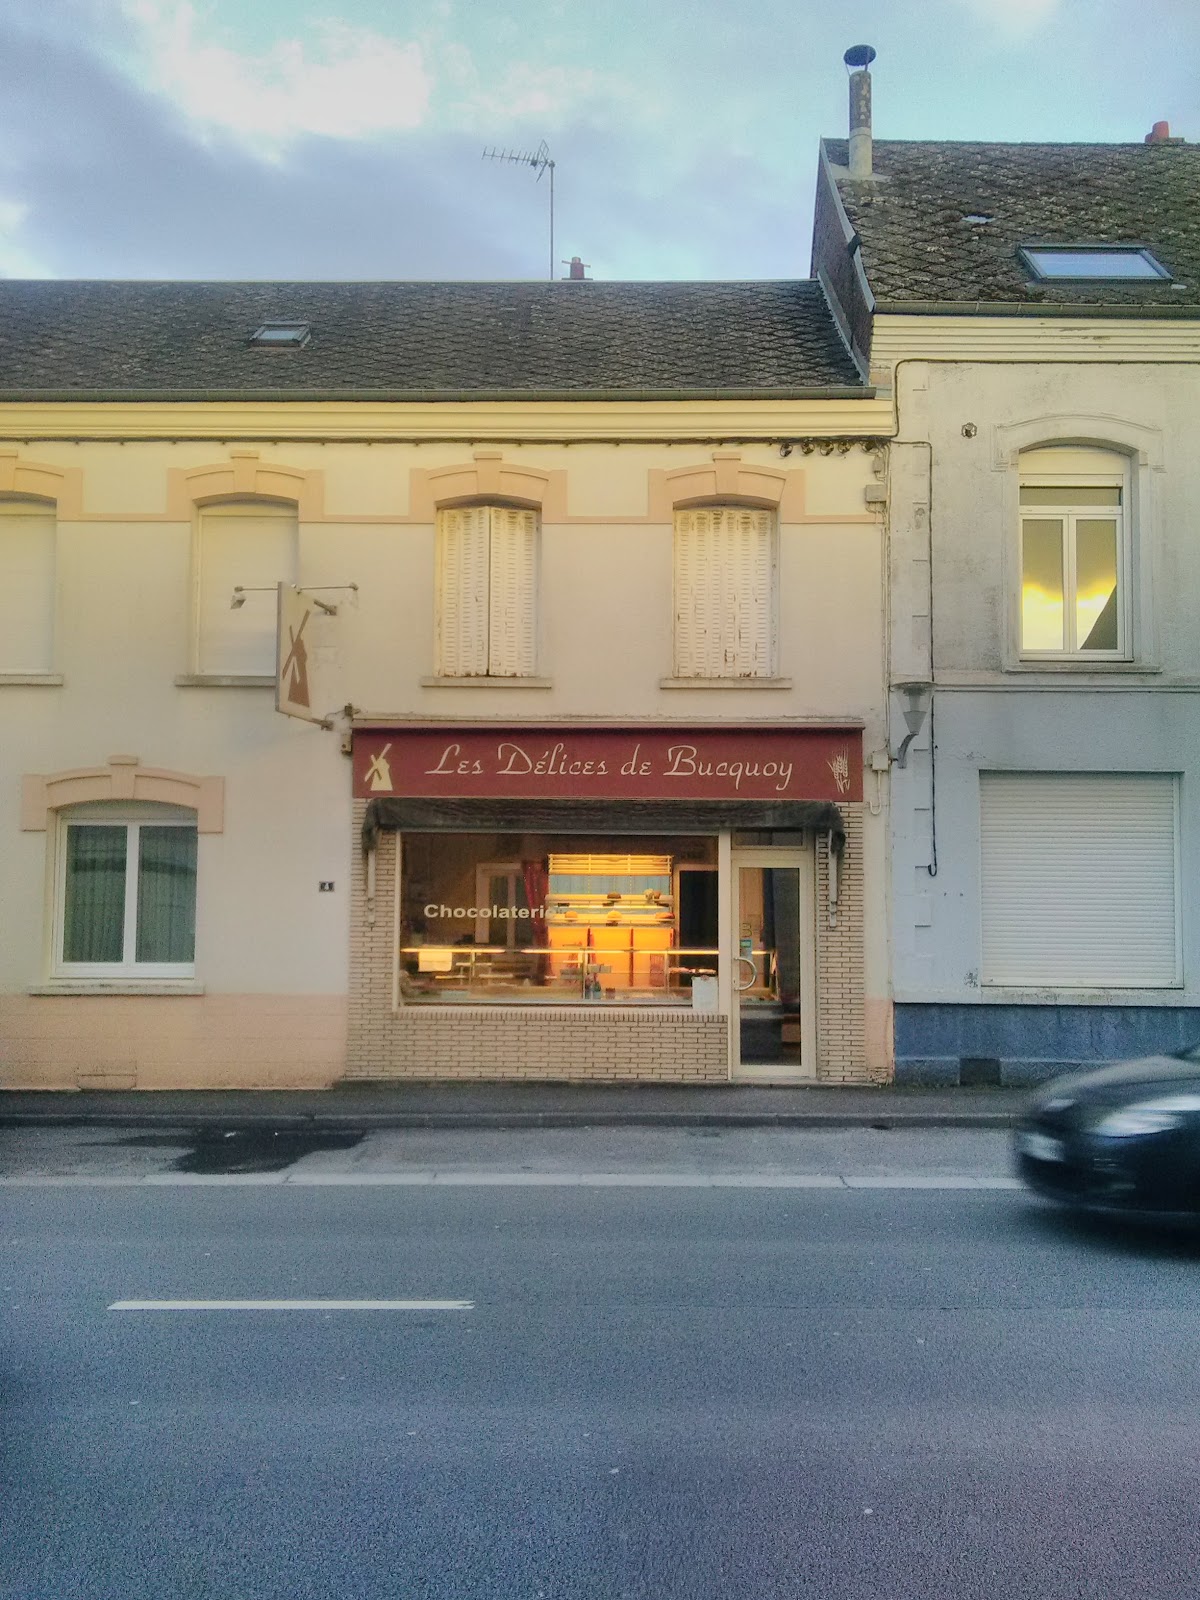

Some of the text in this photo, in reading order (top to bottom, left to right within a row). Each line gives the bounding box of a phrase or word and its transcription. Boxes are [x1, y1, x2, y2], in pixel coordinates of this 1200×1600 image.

[424, 742, 793, 791] Les Délices de Bucquoy
